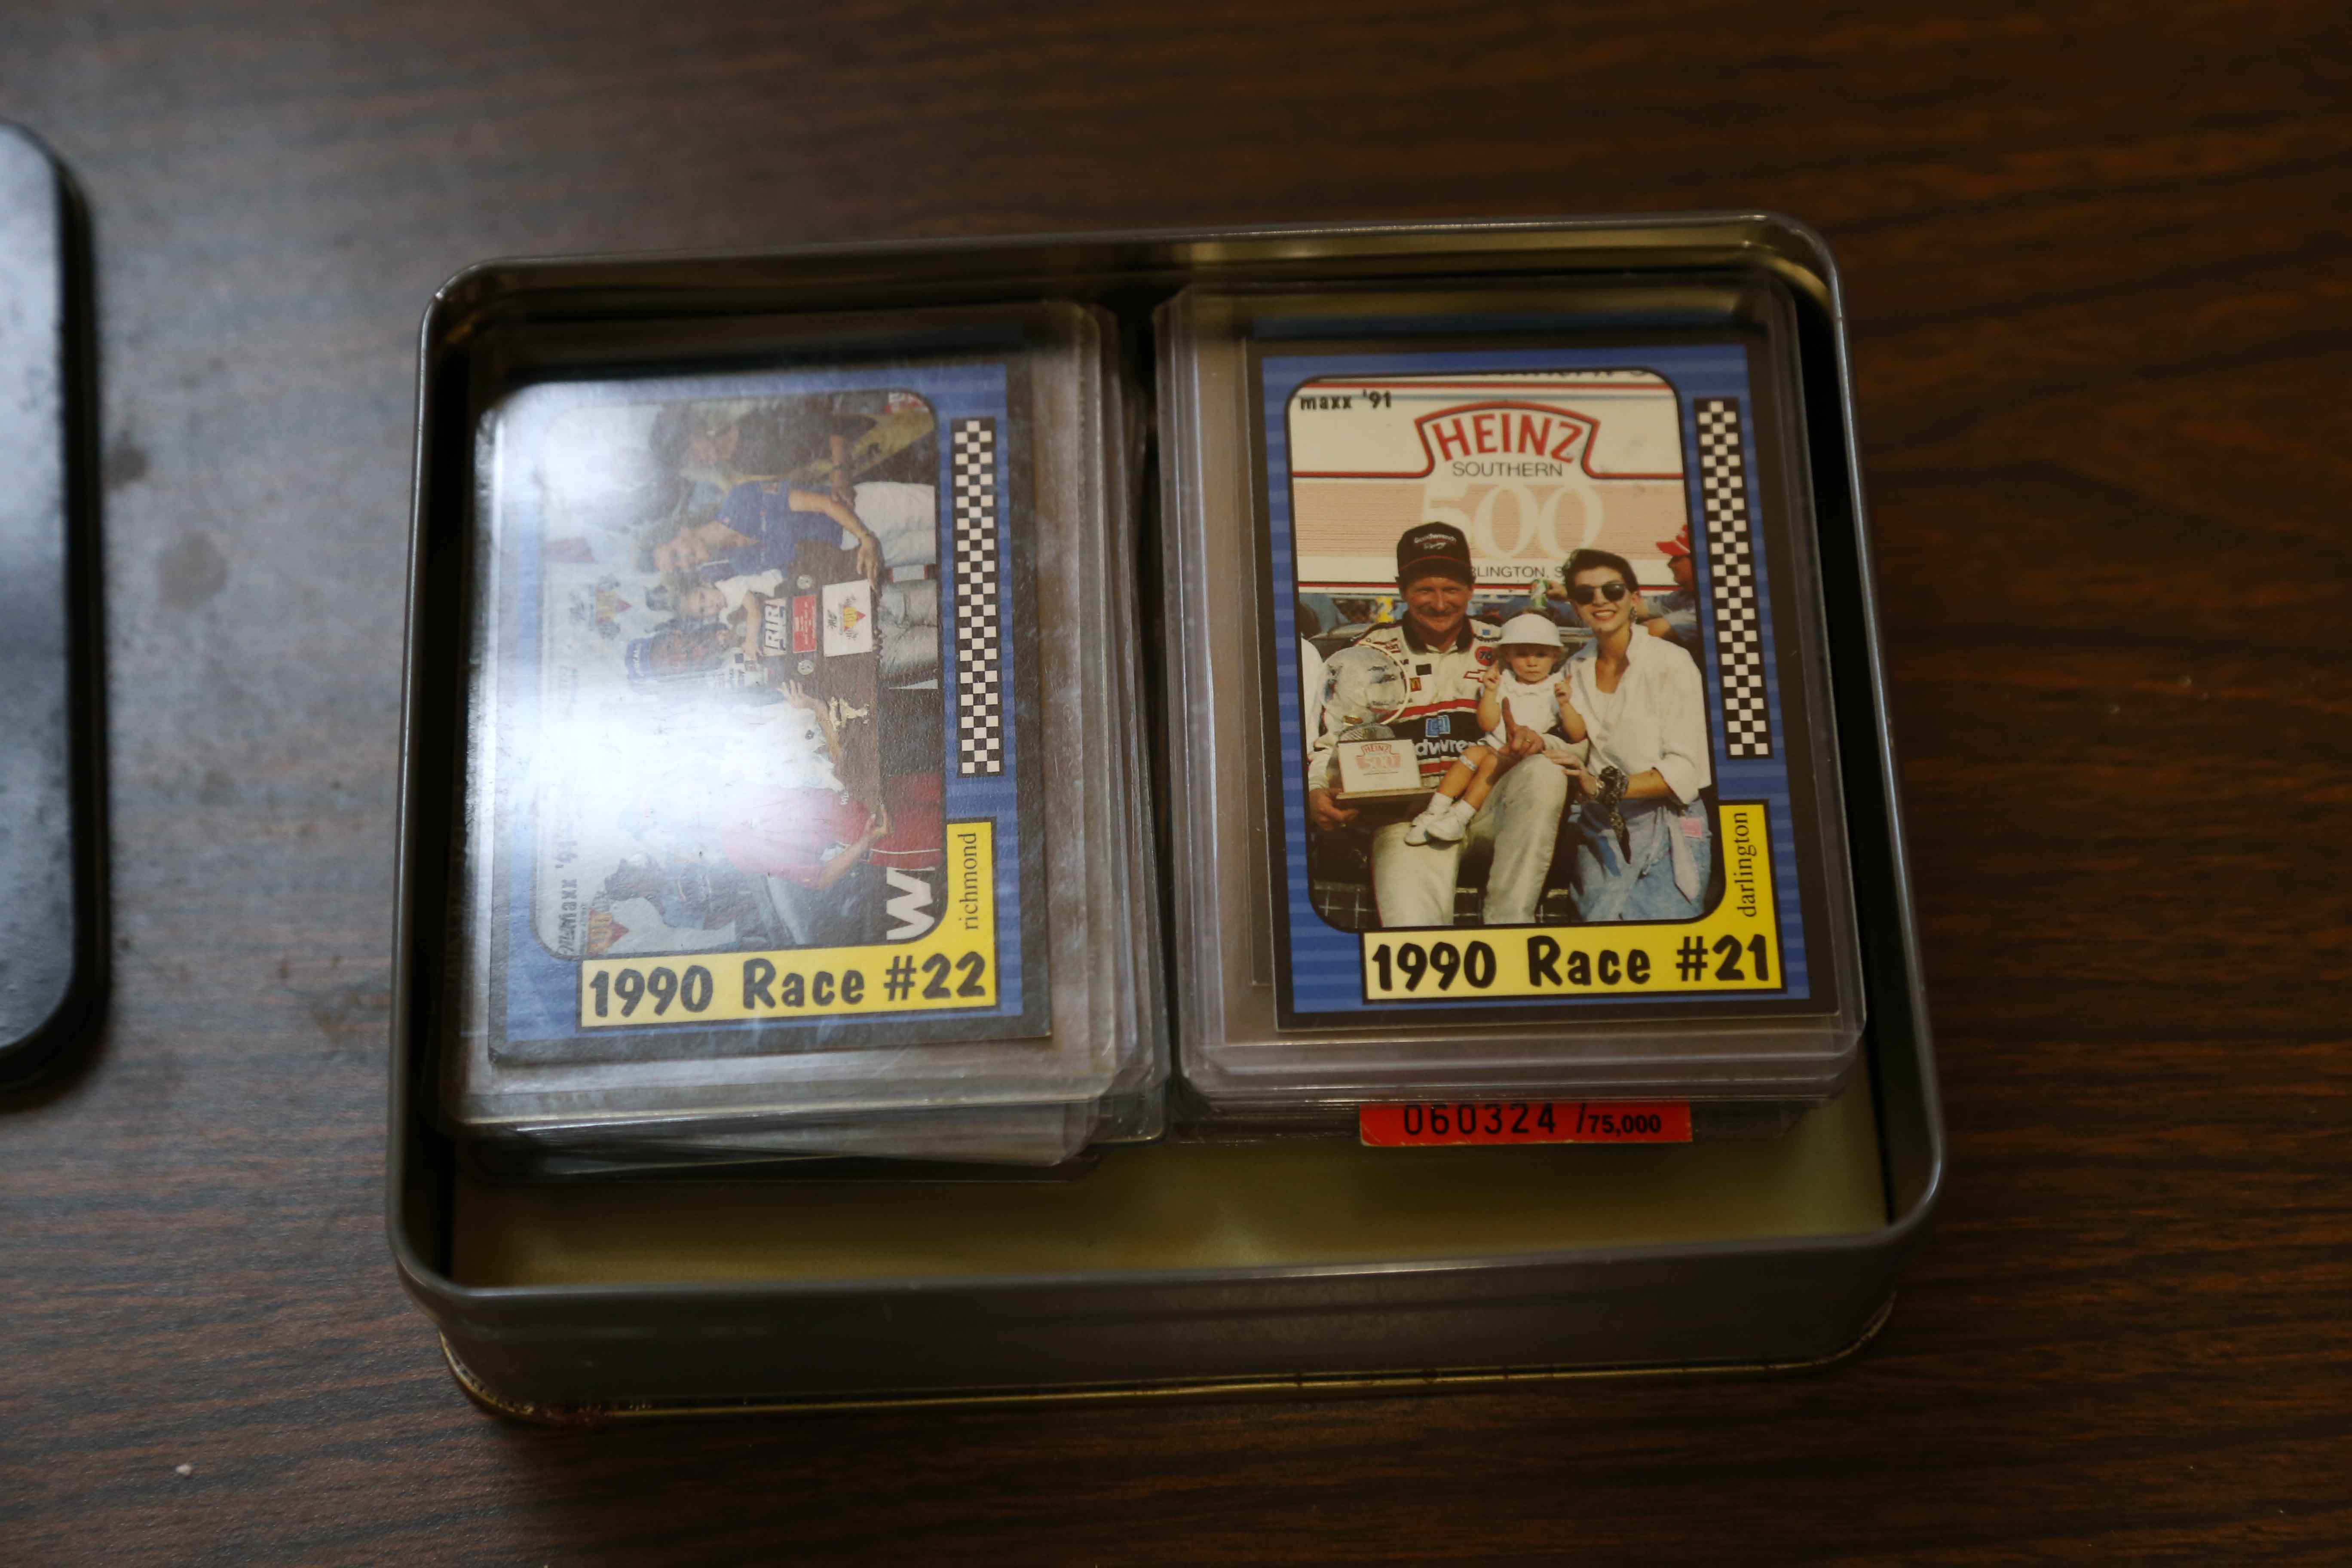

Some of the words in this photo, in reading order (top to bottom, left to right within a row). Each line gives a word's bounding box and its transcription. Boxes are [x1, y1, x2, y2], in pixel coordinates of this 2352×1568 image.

[1300, 395, 1352, 411] maxx
[1362, 389, 1392, 409] '91
[1432, 413, 1584, 464] HEINZ
[1452, 461, 1563, 478] SOUTHERN
[1421, 481, 1605, 560] 500
[956, 832, 980, 931] richmond
[1733, 812, 1757, 917] darlington
[589, 964, 714, 1018] 1990
[743, 957, 864, 1011] Race
[883, 951, 987, 1001] #22
[1372, 940, 1497, 992] 1990
[1527, 935, 1651, 986] Race
[1675, 933, 1770, 982] #21
[1403, 1102, 1556, 1135] 060324
[1576, 1102, 1662, 1135] /75,000
